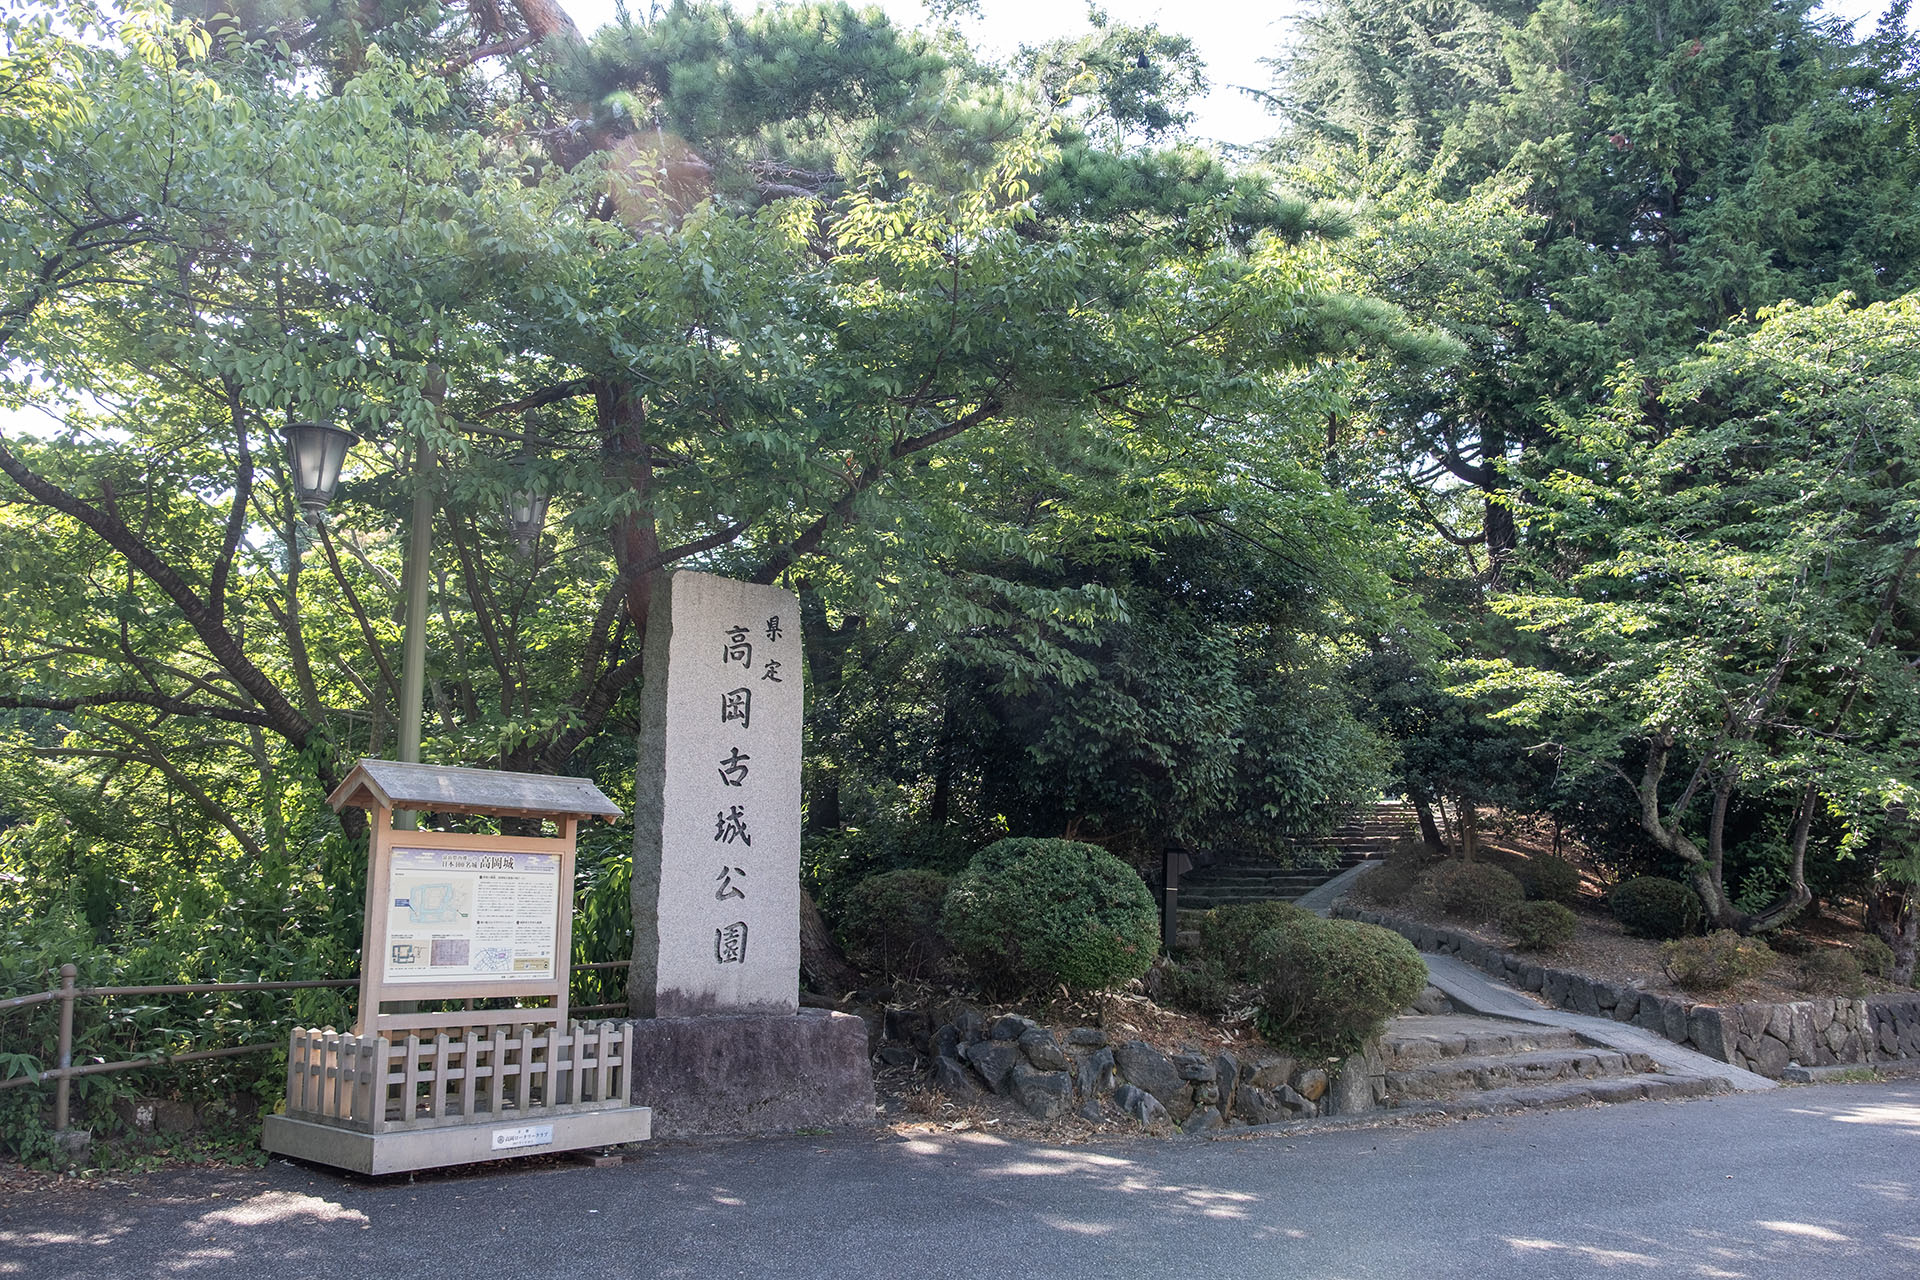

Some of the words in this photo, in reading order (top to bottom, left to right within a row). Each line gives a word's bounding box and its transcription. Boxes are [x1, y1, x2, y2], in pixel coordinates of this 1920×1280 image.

[761, 615, 783, 683] 県定
[714, 625, 752, 964] 高岡古城公園
[480, 856, 514, 869] 高岡城
